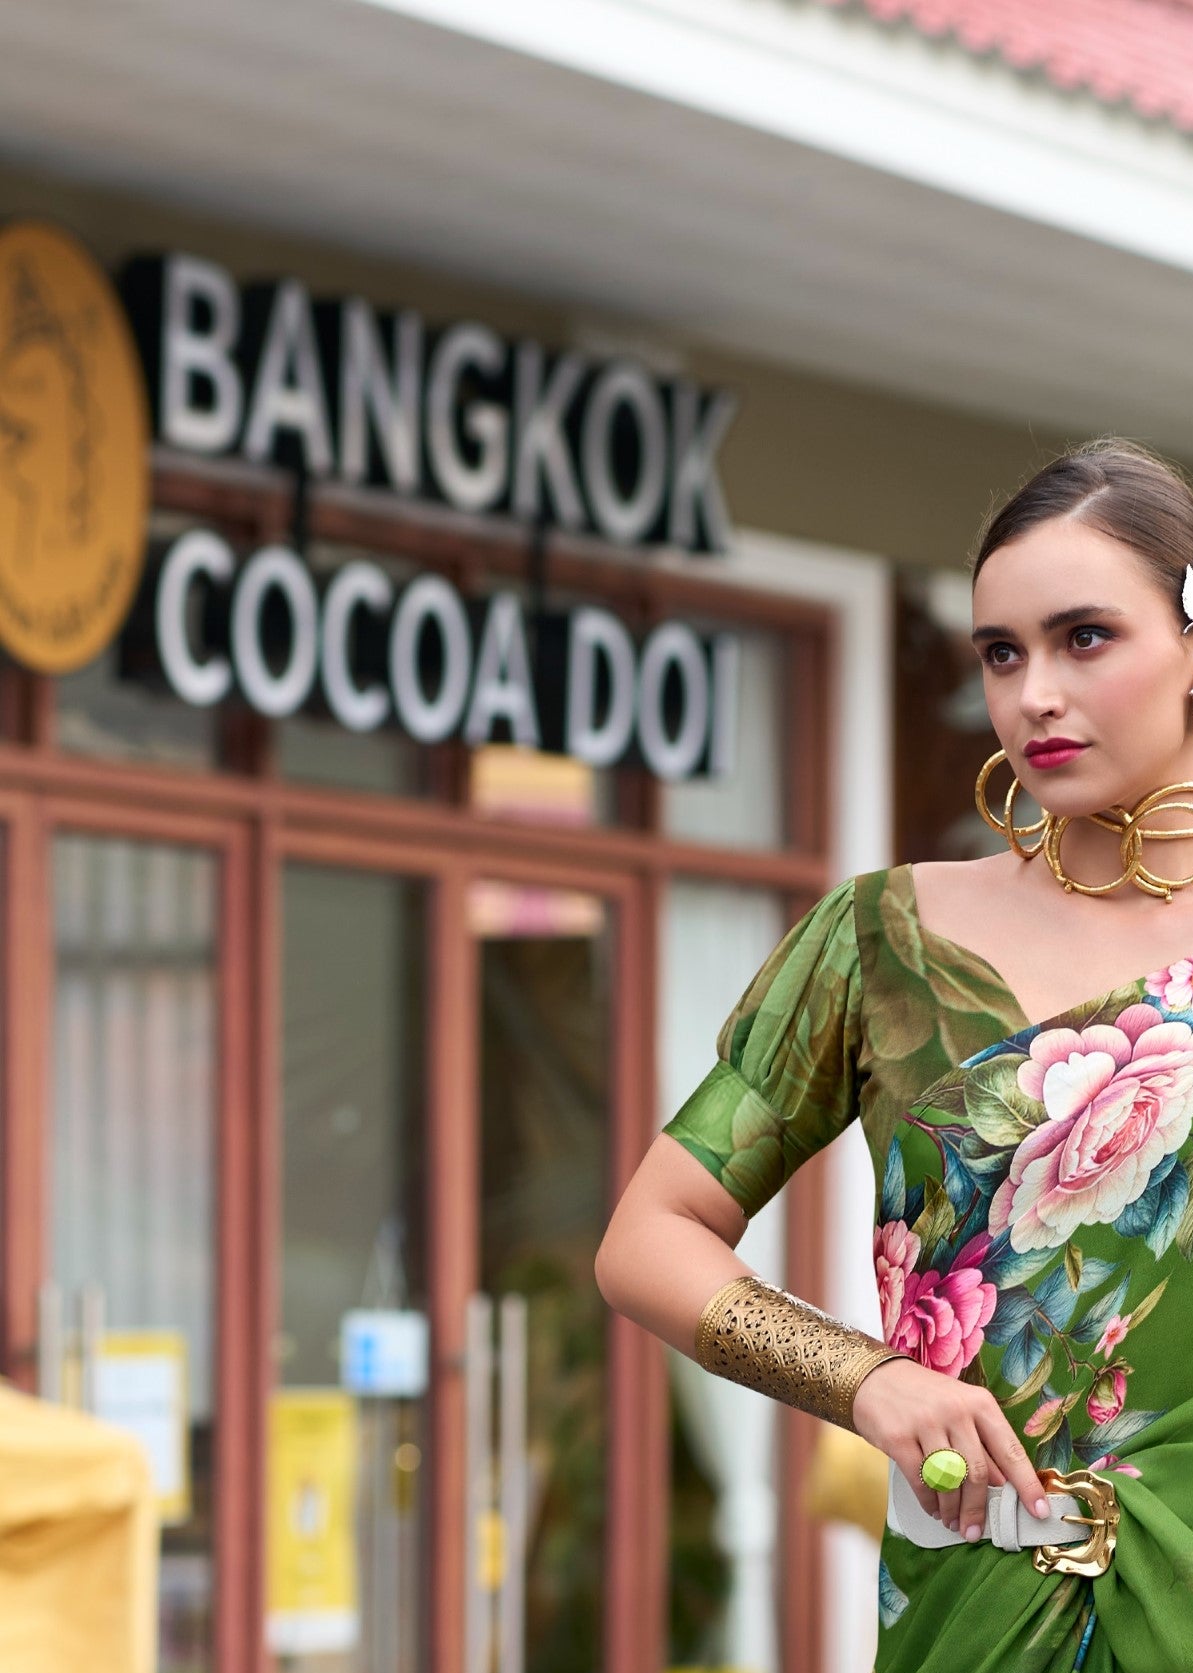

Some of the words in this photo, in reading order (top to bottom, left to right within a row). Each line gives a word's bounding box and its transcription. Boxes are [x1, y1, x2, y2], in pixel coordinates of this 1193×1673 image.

[161, 252, 738, 554] BANGKOK
[155, 529, 540, 751] COCOA
[566, 605, 737, 780] DOI
